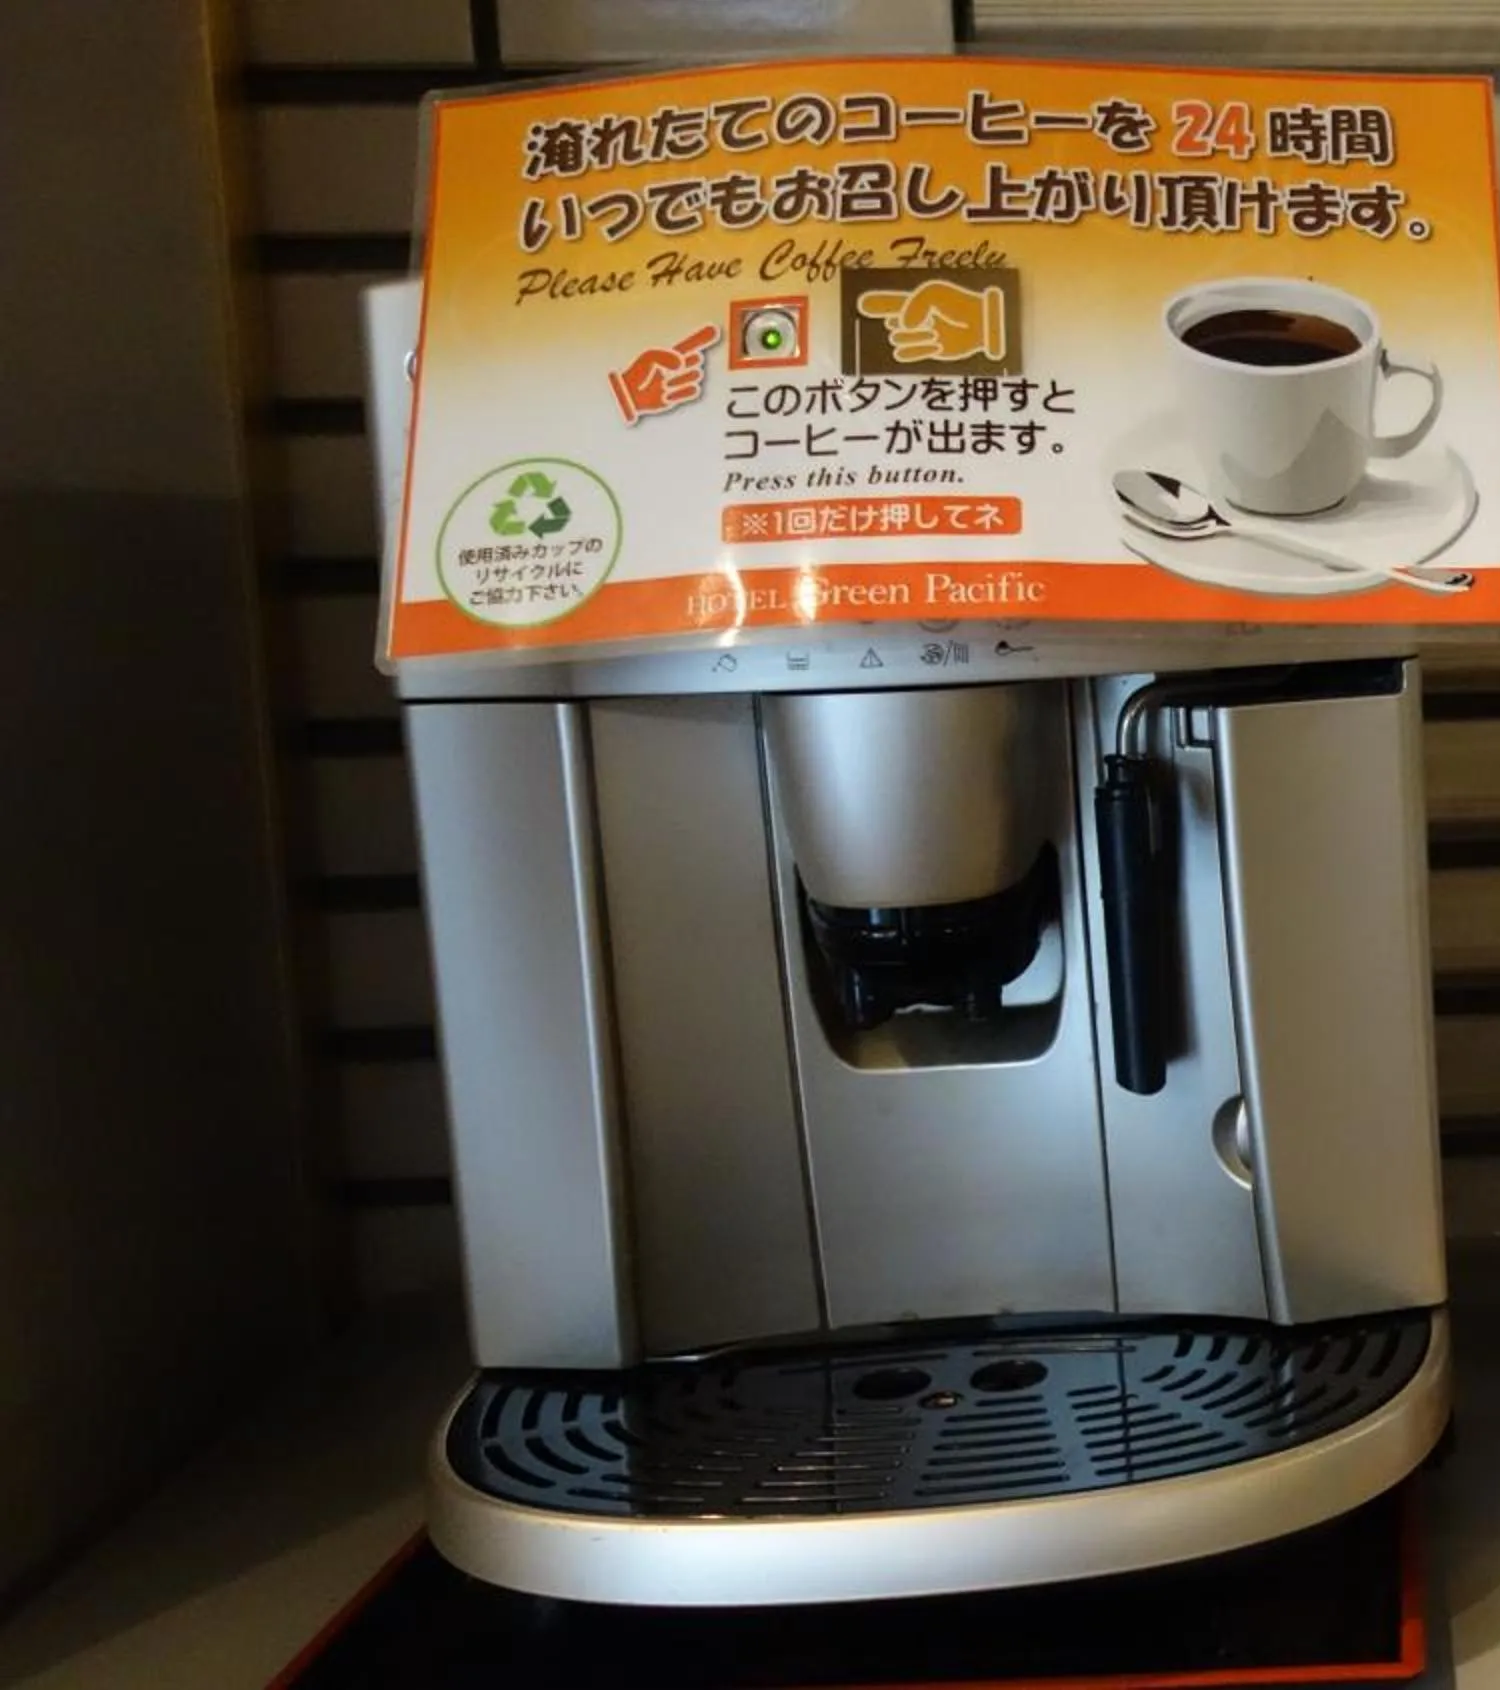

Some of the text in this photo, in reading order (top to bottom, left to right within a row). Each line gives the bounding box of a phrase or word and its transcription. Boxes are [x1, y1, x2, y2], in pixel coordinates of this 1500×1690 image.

[524, 91, 1395, 179] 淹れたてのコーヒーを 24 時間
[519, 162, 1431, 253] いつでもお召し上がり頂けます。
[516, 268, 634, 305] Please
[647, 251, 741, 287] Have
[759, 238, 874, 282] Coffee
[727, 377, 1075, 418] このボタンを押すと
[724, 419, 1064, 460] コーヒーが出ます。
[723, 464, 965, 492] Press this button.
[459, 538, 603, 566] 使用済みカップの
[477, 561, 583, 585] リサイクルに
[926, 571, 1046, 604] Pacific
